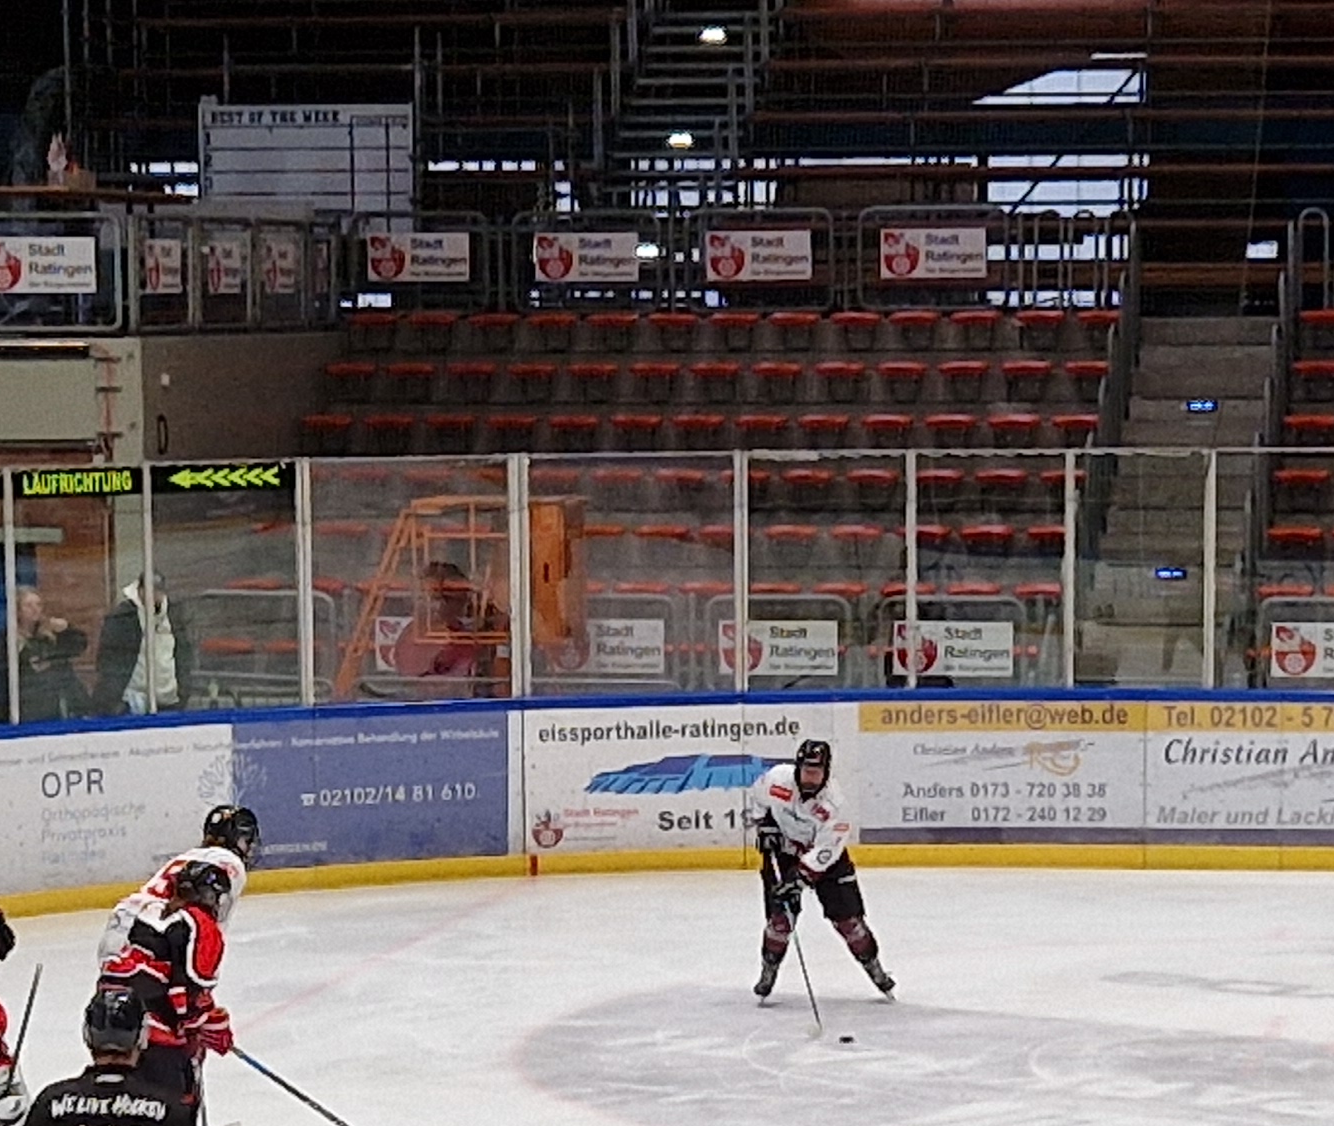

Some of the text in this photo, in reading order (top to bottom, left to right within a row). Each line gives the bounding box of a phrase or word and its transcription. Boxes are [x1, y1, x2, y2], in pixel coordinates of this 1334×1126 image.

[28, 243, 66, 256] Stadt
[768, 625, 808, 639] Stadt
[943, 626, 983, 640] Stadt
[881, 703, 1129, 730] anders-eifler@web.de
[1164, 706, 1203, 729] Tel.
[1210, 706, 1278, 729] 02102
[1301, 706, 1315, 729] 5
[538, 715, 801, 747] eissporthalle-ratingen.de
[1164, 737, 1290, 767] Christian
[41, 768, 105, 799] OPR
[902, 781, 965, 799] Anders
[970, 781, 1010, 799] 0173
[1026, 781, 1057, 799] 720
[657, 809, 714, 831] Seit
[901, 806, 946, 823] Eifler
[970, 806, 1011, 823] 0172
[1026, 806, 1057, 823] 240
[1063, 806, 1083, 823] 12
[1087, 806, 1108, 823] 29
[1155, 805, 1220, 827] Maler
[1224, 806, 1268, 827] und
